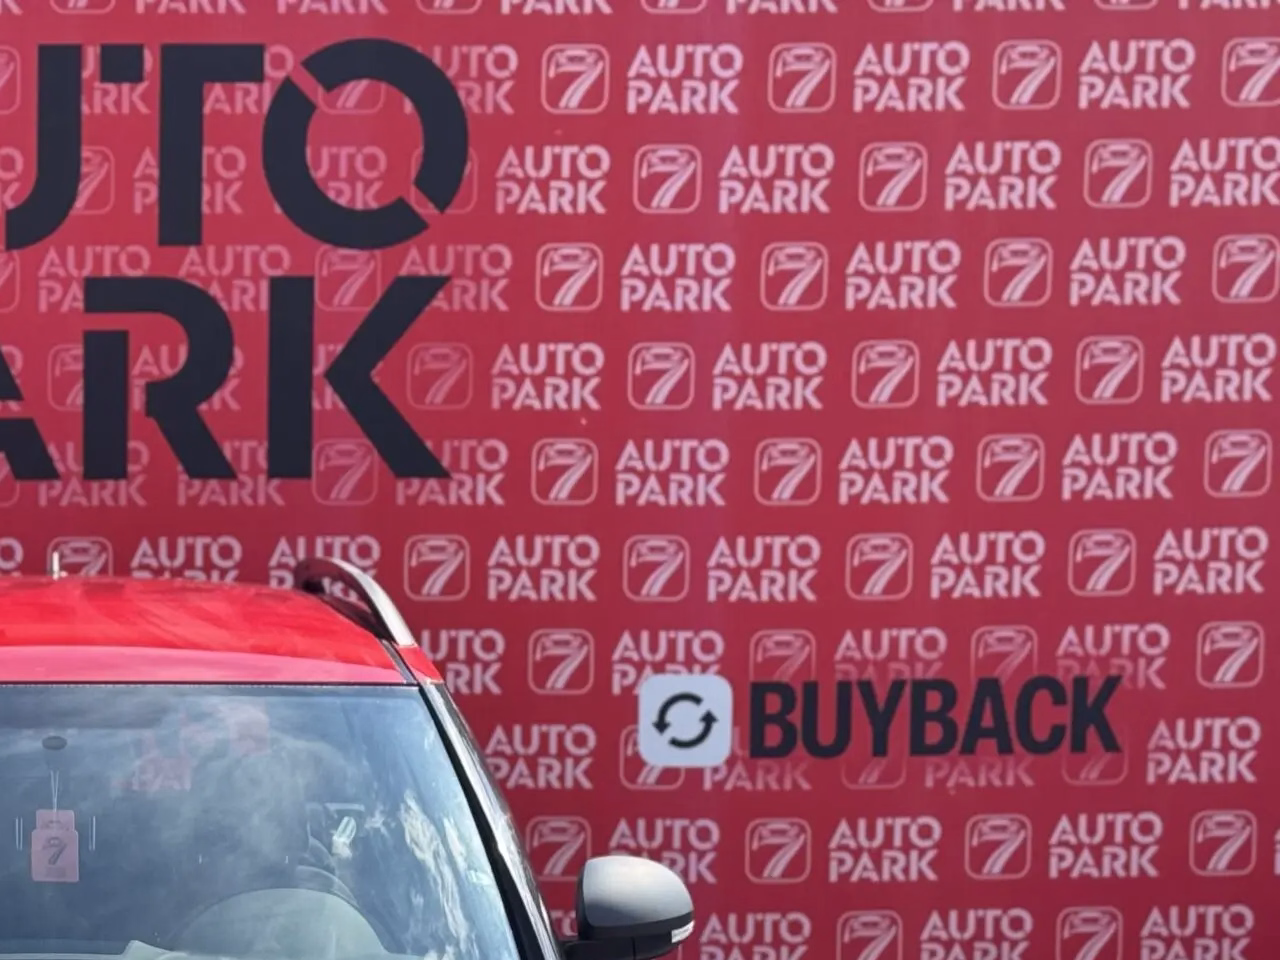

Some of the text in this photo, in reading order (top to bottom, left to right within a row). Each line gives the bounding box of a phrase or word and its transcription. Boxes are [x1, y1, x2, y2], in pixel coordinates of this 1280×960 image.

[628, 44, 743, 78] AUTO
[854, 41, 970, 76] AUTO
[1080, 39, 1195, 74] AUTO
[627, 79, 738, 114] PARK
[854, 76, 965, 112] PARK
[1079, 74, 1190, 109] PARK
[497, 145, 610, 179] AUTO
[719, 143, 834, 178] AUTO
[945, 140, 1061, 175] AUTO
[1170, 137, 1280, 172] AUTO
[497, 180, 606, 214] PARK
[719, 179, 830, 214] PARK
[945, 175, 1057, 210] PARK
[1170, 172, 1280, 207] PARK
[621, 243, 736, 276] AUTO
[846, 240, 961, 275] AUTO
[1070, 236, 1186, 271] AUTO
[621, 278, 731, 311] PARK
[846, 274, 957, 310] PARK
[1070, 271, 1181, 306] PARK
[492, 342, 604, 376] AUTO
[713, 341, 827, 376] AUTO
[937, 338, 1052, 372] AUTO
[1162, 333, 1280, 369] AUTO
[492, 376, 600, 410] PARK
[713, 376, 823, 410] PARK
[937, 372, 1048, 407] PARK
[1161, 368, 1272, 403] PARK
[616, 439, 729, 472] AUTO
[839, 436, 953, 471] AUTO
[1063, 432, 1177, 466] AUTO
[616, 473, 725, 506] PARK
[839, 470, 949, 505] PARK
[1062, 465, 1173, 500] PARK
[131, 536, 242, 568] AUTO
[488, 535, 600, 568] AUTO
[707, 535, 820, 568] AUTO
[931, 530, 1045, 565] AUTO
[1154, 526, 1268, 561] AUTO
[488, 568, 596, 601] PARK
[707, 568, 816, 602] PARK
[931, 565, 1040, 599] PARK
[1154, 560, 1264, 595] PARK
[612, 630, 724, 662] AUTO
[835, 628, 946, 660] AUTO
[1058, 623, 1170, 655] AUTO
[749, 676, 1123, 759] BUYBACK
[1149, 716, 1261, 750] AUTO
[485, 724, 596, 756] AUTO
[487, 757, 593, 789] PARK
[1147, 750, 1256, 783] PARK
[610, 819, 720, 850] AUTO
[829, 816, 941, 849] AUTO
[1049, 812, 1163, 845] AUTO
[829, 849, 937, 882] PARK
[1049, 845, 1158, 878] PARK
[700, 912, 811, 944] AUTO
[920, 908, 1032, 940] AUTO
[1141, 904, 1254, 937] AUTO
